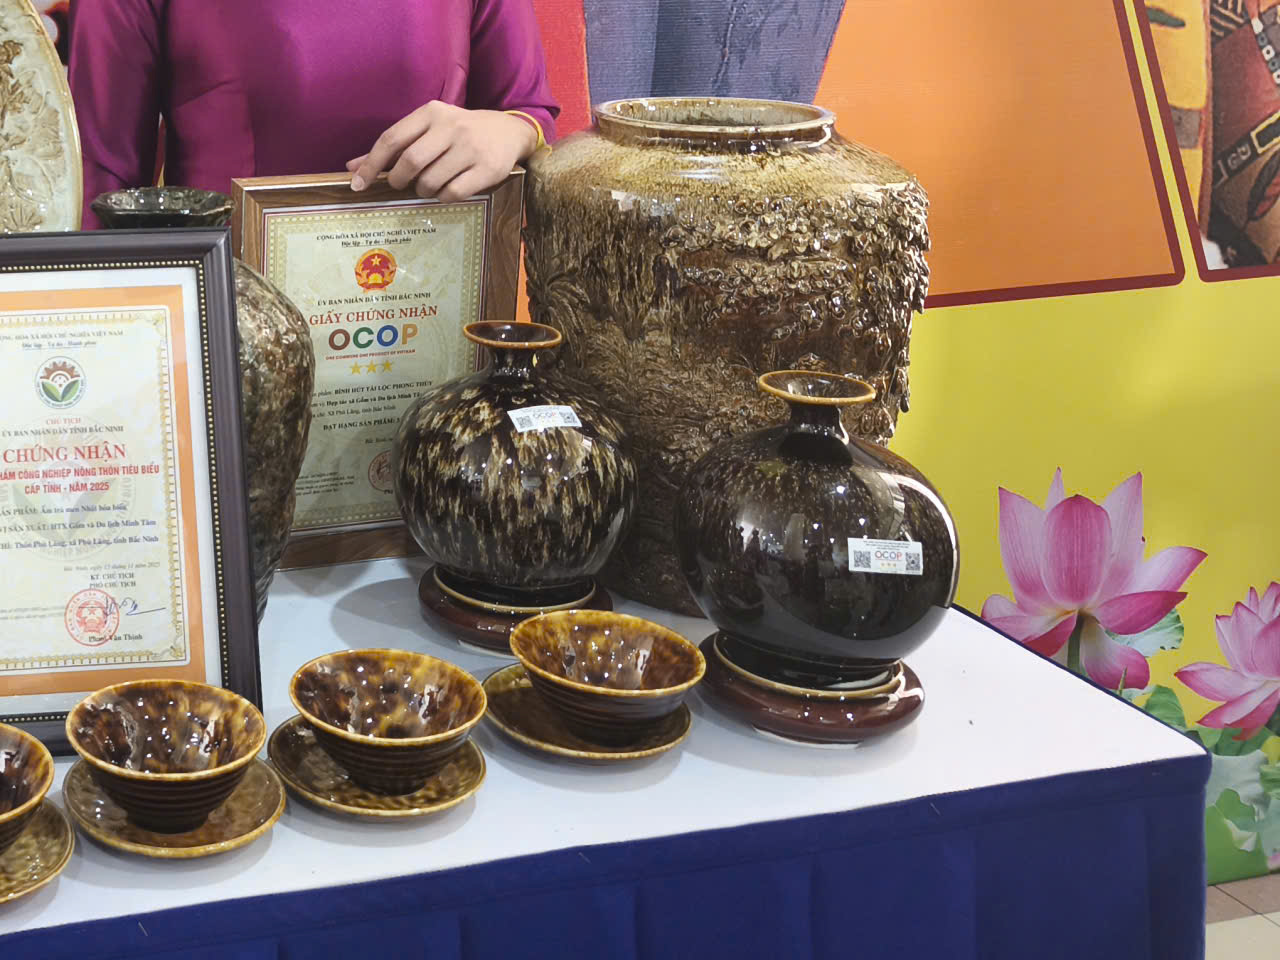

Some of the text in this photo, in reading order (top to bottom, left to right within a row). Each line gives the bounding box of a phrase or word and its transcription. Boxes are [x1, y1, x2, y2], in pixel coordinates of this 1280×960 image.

[309, 303, 437, 325] GIẤY CHỨNG NHẬN
[328, 323, 418, 351] OCOP
[3, 441, 126, 464] CHỨNG NHẬN
[18, 470, 40, 480] CÔNG
[42, 468, 72, 479] NGHIỆP
[74, 467, 96, 477] NÔNG
[99, 466, 120, 476] THÔN
[121, 465, 139, 474] TIÊU
[141, 462, 159, 474] BIỂU
[24, 481, 109, 494] CẤP TỈNH NĂM 2025
[874, 550, 903, 560] OCOP
